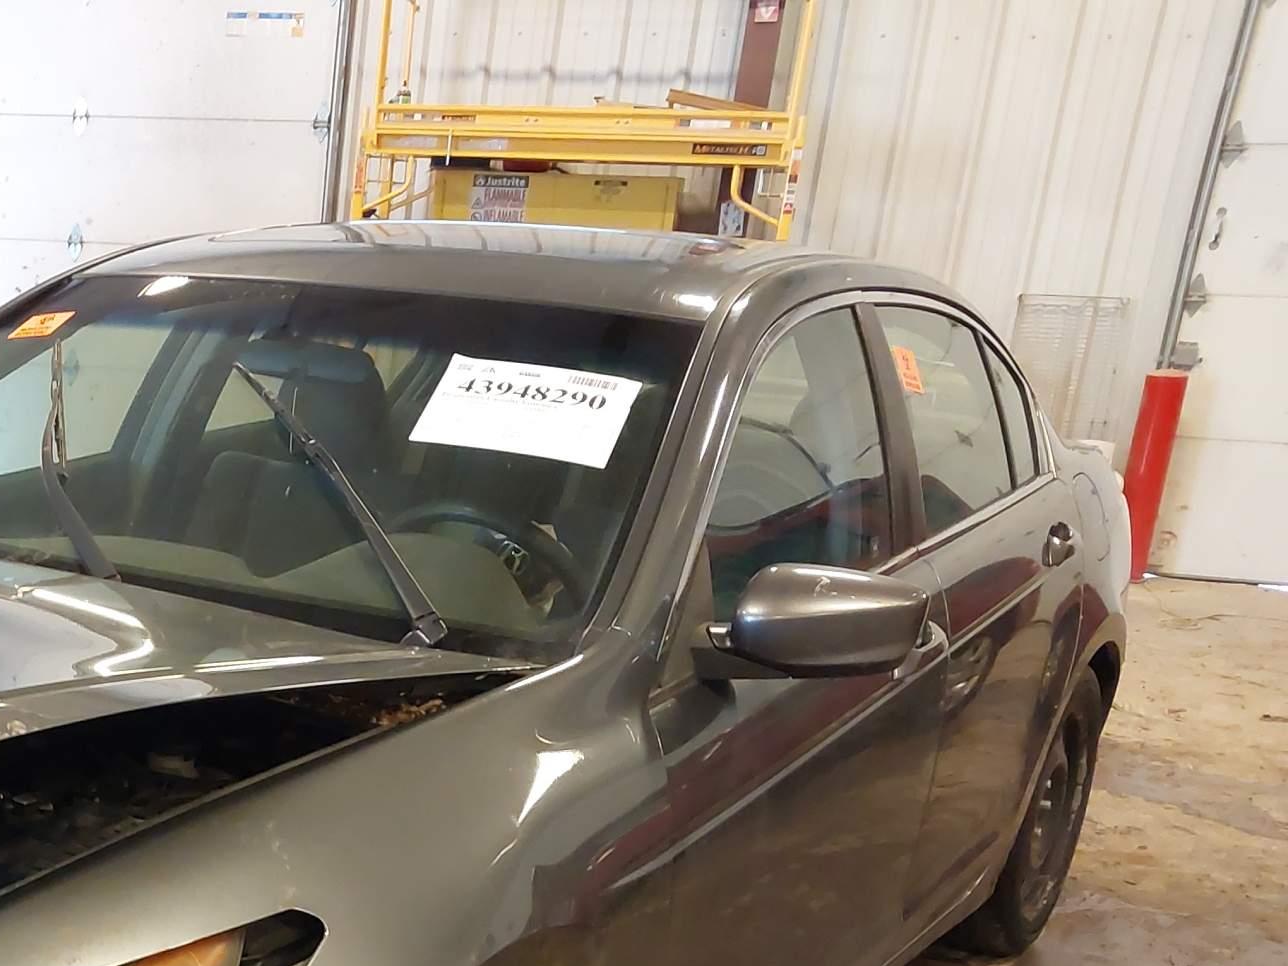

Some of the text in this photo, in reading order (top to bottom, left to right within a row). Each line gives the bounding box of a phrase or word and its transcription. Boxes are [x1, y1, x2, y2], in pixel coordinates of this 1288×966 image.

[487, 176, 526, 187] Justrite
[484, 188, 525, 201] FLAMMABLE
[457, 378, 607, 410] 43948290
